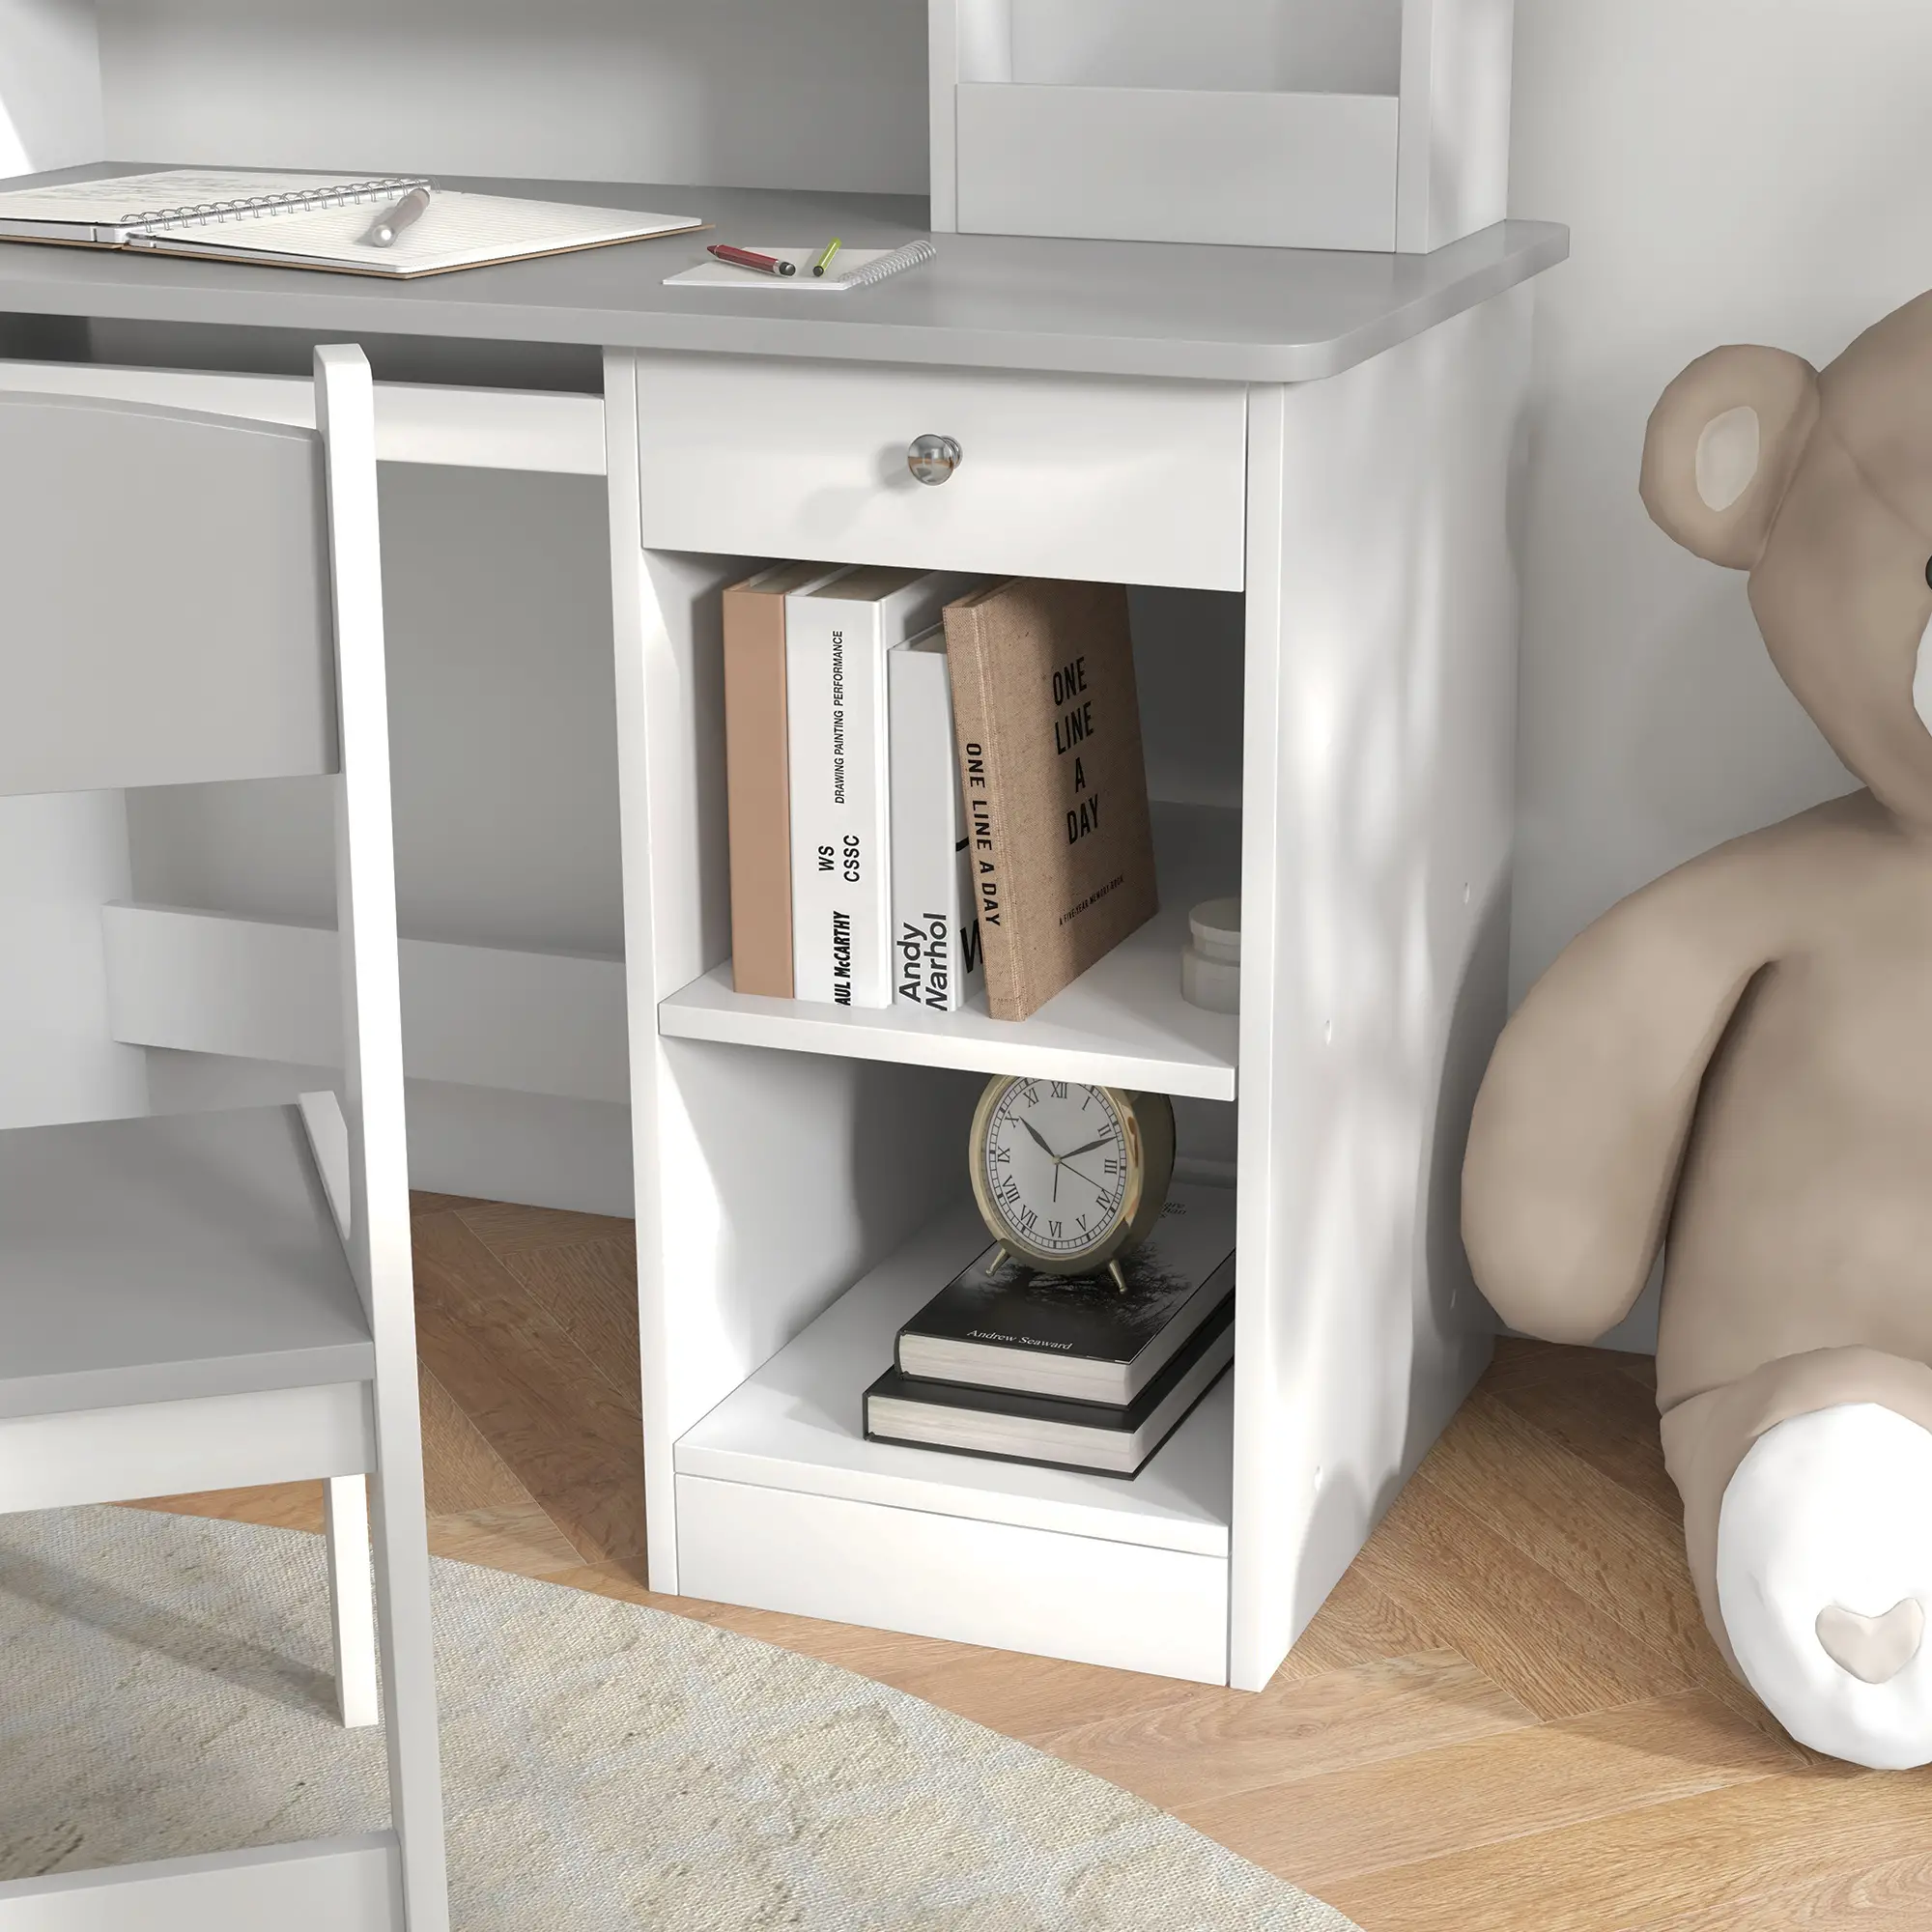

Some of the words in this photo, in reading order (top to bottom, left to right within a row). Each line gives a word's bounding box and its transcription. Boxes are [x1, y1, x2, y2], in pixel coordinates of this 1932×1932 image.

[833, 631, 843, 706] PERFORMANCE
[1053, 657, 1087, 705] ONE
[834, 710, 844, 755] PAINTING
[1055, 701, 1094, 754] LINE
[835, 757, 845, 804] DRAWING
[966, 743, 985, 788] ONE
[1075, 757, 1086, 793] A
[972, 800, 992, 851] LINE
[1066, 794, 1098, 845] DAY
[818, 845, 835, 871] WS
[843, 835, 860, 883] CSSC
[979, 860, 995, 874] A
[981, 882, 1001, 926] DAY
[833, 910, 850, 979] McCARTHY
[896, 922, 927, 1004] Andy
[923, 912, 948, 1011] Warhol
[834, 981, 851, 1007] AUL
[1022, 1087, 1039, 1108] XI
[1051, 1080, 1068, 1099] XII
[1005, 1110, 1019, 1128] X
[997, 1146, 1010, 1164] IX
[1002, 1175, 1021, 1205] VIII
[1020, 1204, 1038, 1230] VII
[1048, 1220, 1063, 1237] VI
[1075, 1213, 1087, 1232] V
[966, 1329, 1017, 1343] Andrew
[1018, 1336, 1074, 1350] Seaward
